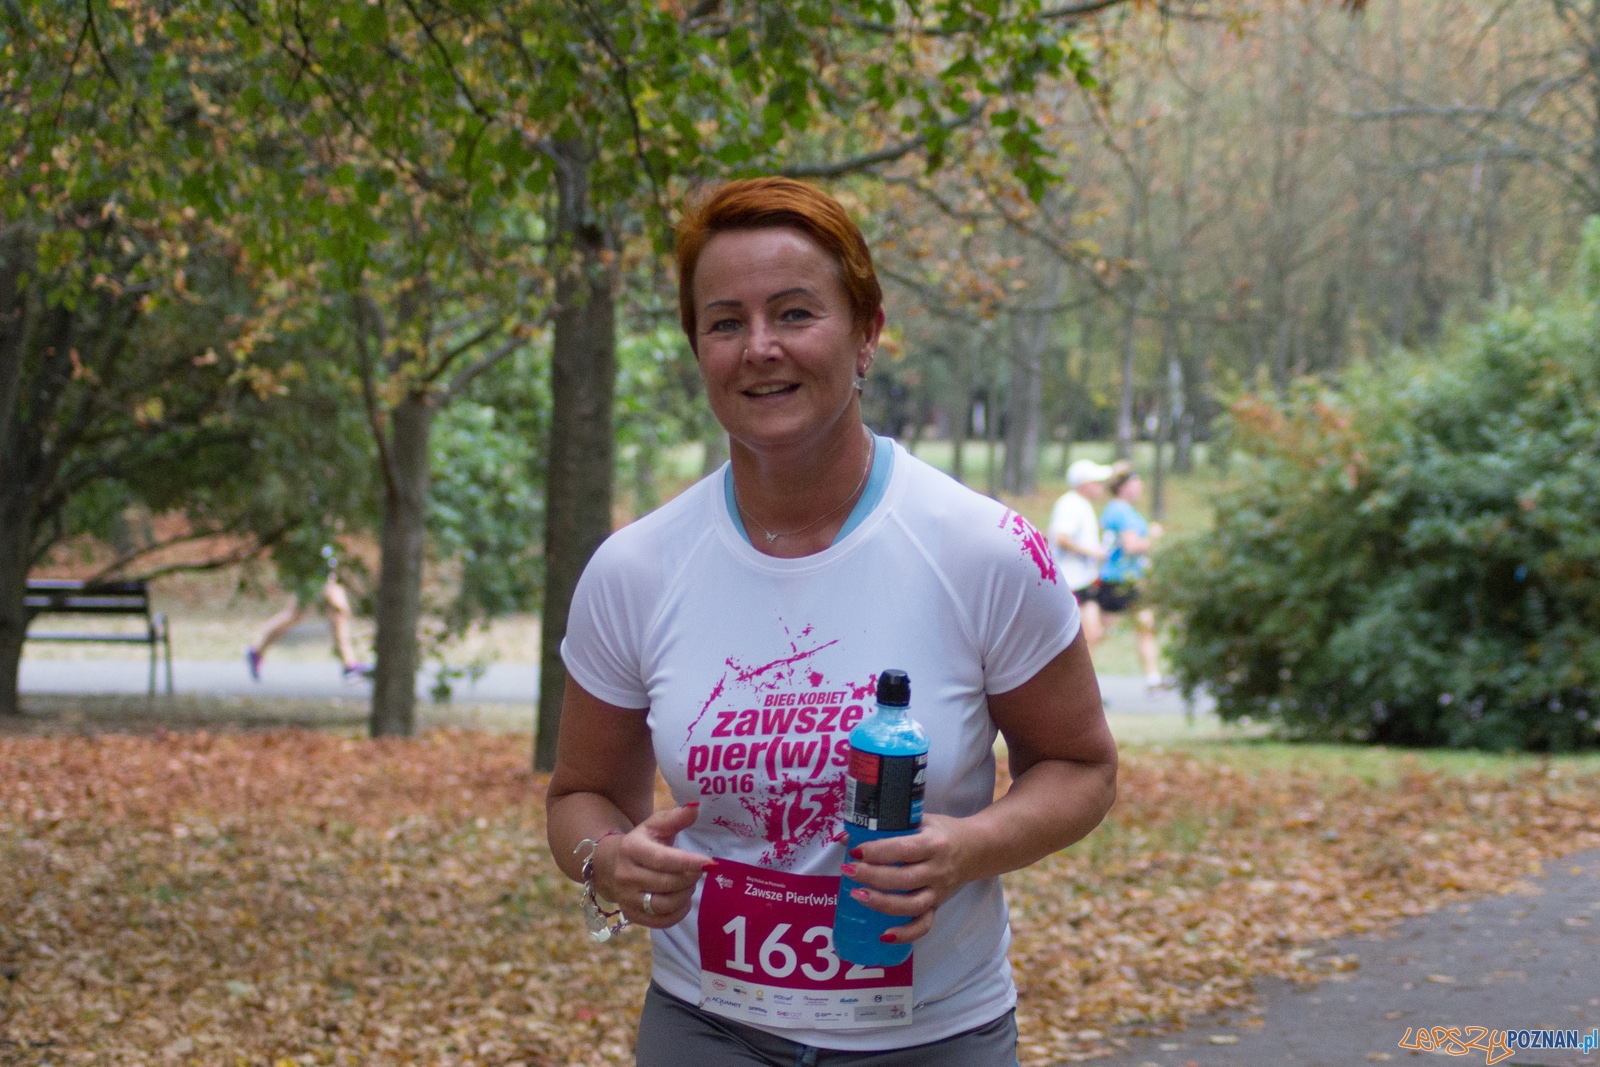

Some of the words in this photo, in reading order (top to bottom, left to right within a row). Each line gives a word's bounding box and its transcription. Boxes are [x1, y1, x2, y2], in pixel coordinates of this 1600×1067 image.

[764, 693, 797, 707] BIEG
[797, 691, 848, 706] KOBIET
[711, 704, 864, 738] zawsze
[687, 734, 850, 781] pier(w)s
[699, 773, 754, 795] 2016
[744, 883, 783, 902] Zawsze
[786, 891, 838, 907] Pier(w)si
